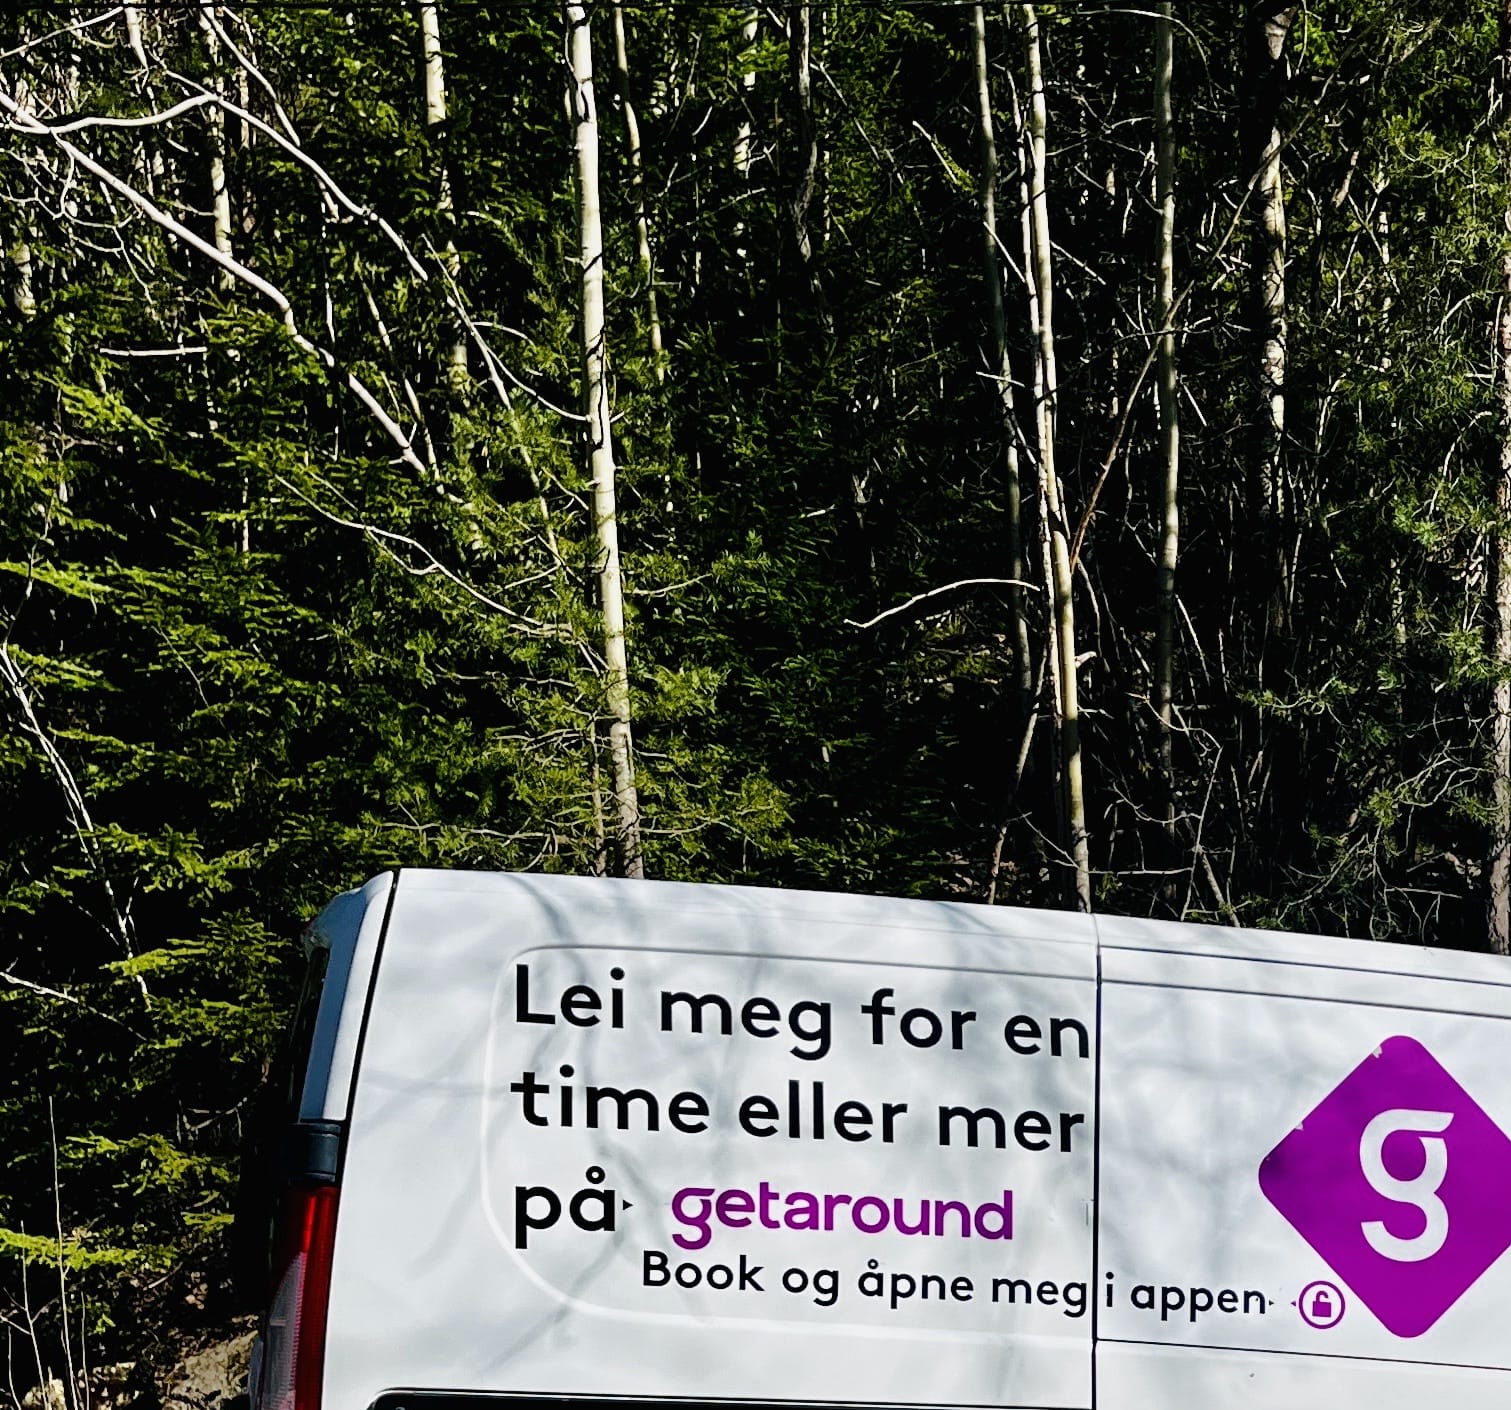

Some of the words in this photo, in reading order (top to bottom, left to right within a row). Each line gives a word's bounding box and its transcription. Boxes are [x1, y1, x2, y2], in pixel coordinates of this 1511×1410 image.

[516, 963, 625, 1029] Lei
[660, 991, 832, 1061] meg
[860, 987, 977, 1051] for
[1004, 1014, 1090, 1059] en
[510, 1064, 710, 1134] time
[738, 1079, 908, 1144] eller
[938, 1105, 1085, 1153] mer
[515, 1165, 616, 1250] på
[671, 1181, 1014, 1250] getaround
[1359, 1108, 1455, 1263] g
[643, 1249, 765, 1292] Book
[782, 1267, 839, 1307] og
[857, 1258, 974, 1308] åpne
[991, 1278, 1087, 1318] meg
[1105, 1271, 1115, 1308] i
[1130, 1284, 1266, 1323] appen
